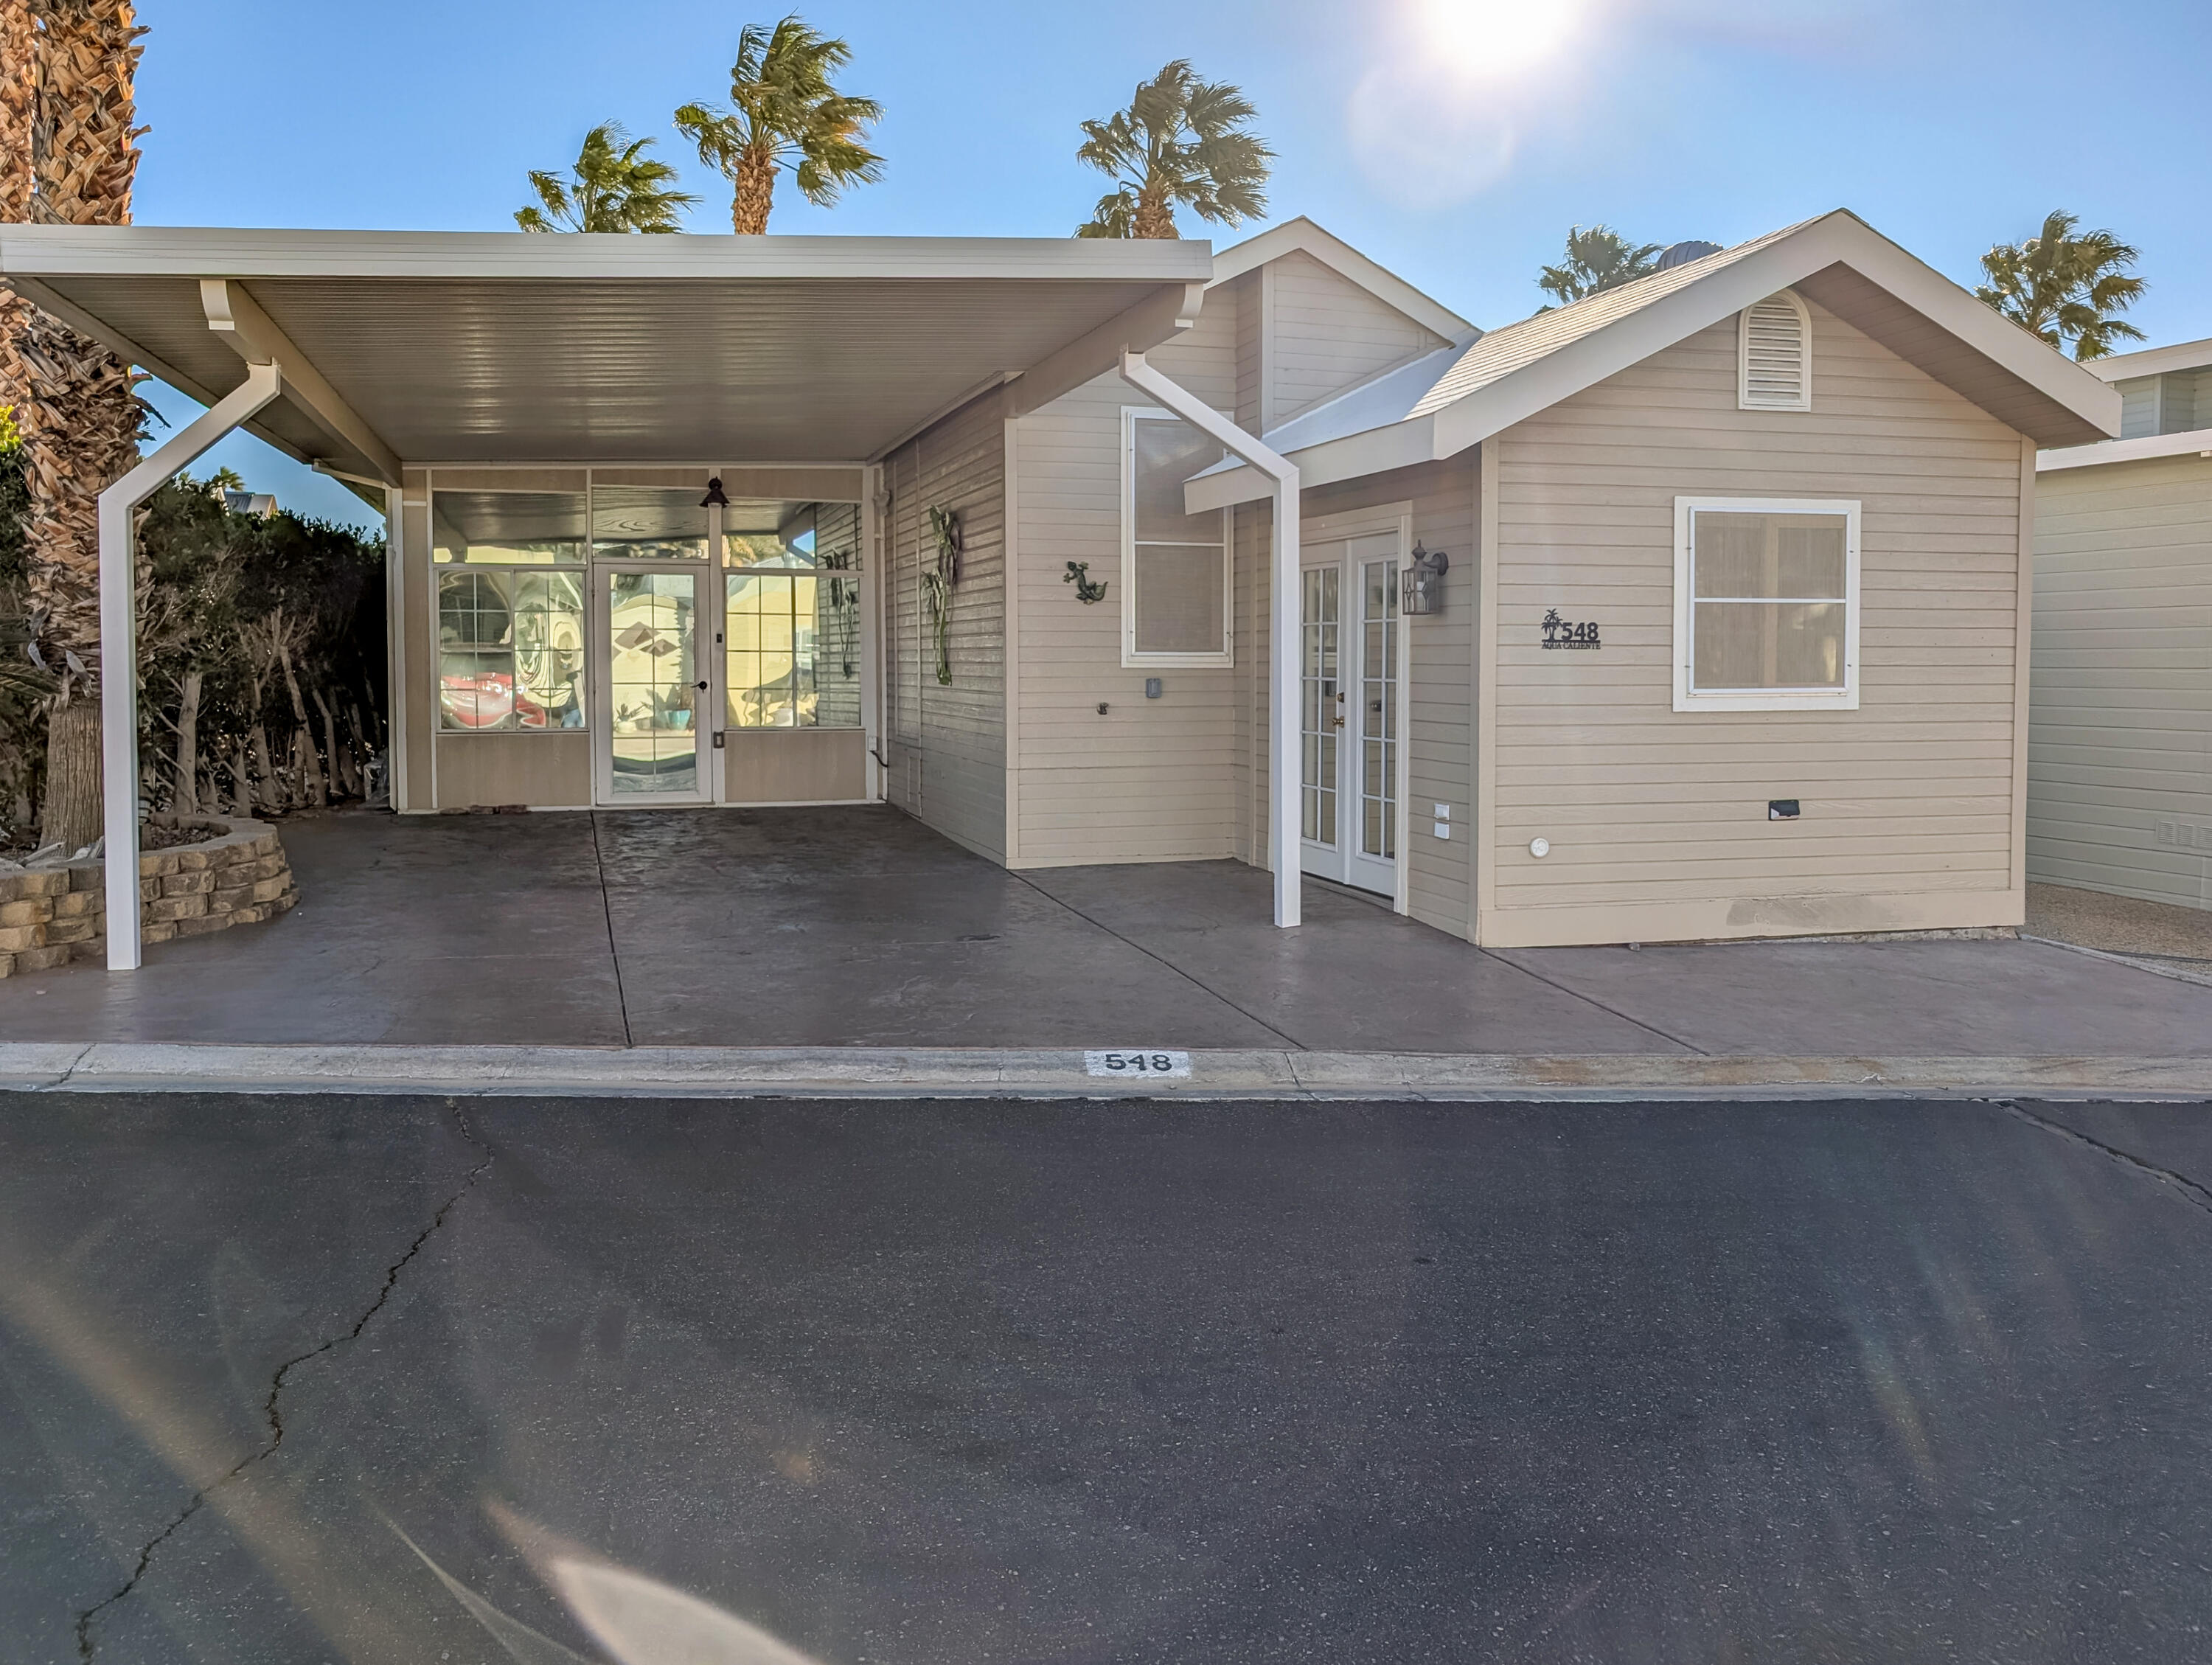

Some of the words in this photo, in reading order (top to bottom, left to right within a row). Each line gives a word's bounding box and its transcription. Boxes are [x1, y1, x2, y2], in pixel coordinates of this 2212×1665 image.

[1561, 622, 1599, 641] 548
[1542, 642, 1562, 650] AQUA
[1563, 642, 1601, 650] CALIENTE
[1105, 1054, 1172, 1071] 548
